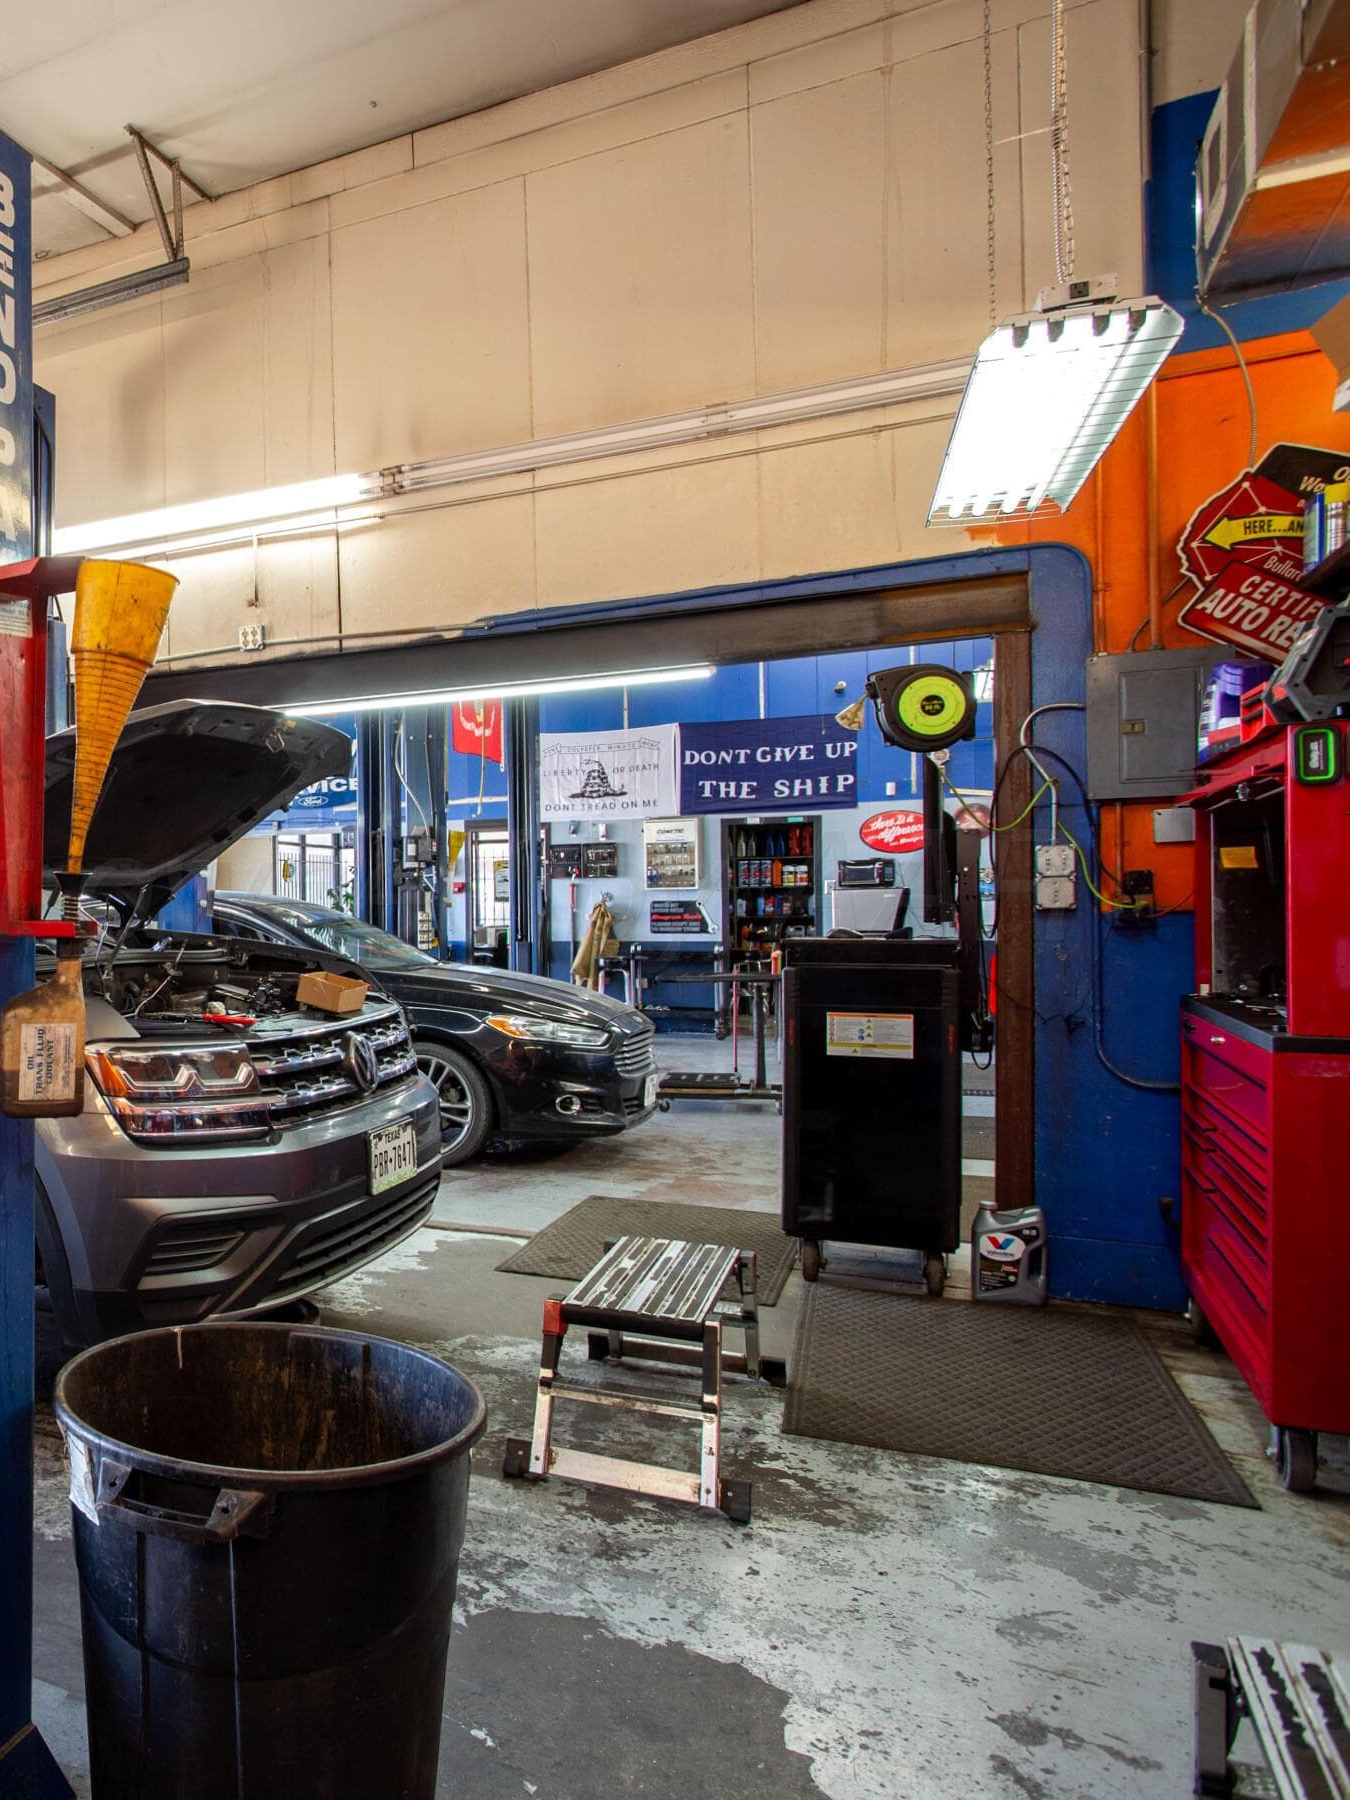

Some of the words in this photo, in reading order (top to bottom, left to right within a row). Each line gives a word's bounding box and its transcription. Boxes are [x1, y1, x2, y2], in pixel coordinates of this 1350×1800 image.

[1263, 555, 1304, 582] Bullar
[1195, 588, 1270, 631] AUTO
[1239, 575, 1324, 621] CERTIF
[683, 749, 750, 765] DONT
[756, 744, 814, 763] GIVE
[825, 741, 858, 759] UP
[612, 767, 625, 775] OR
[629, 763, 659, 773] DEATH
[698, 780, 757, 799] THE
[773, 774, 855, 798] SHIP
[545, 803, 579, 812] DONT
[581, 802, 616, 811] TREAD
[621, 800, 638, 809] ON
[642, 799, 658, 808] ME
[37, 1028, 45, 1057] FLUID
[27, 1056, 35, 1070] OIL
[46, 1040, 54, 1085] COOLANT
[35, 1062, 43, 1094] TRANS
[384, 1129, 401, 1144] TEXAS
